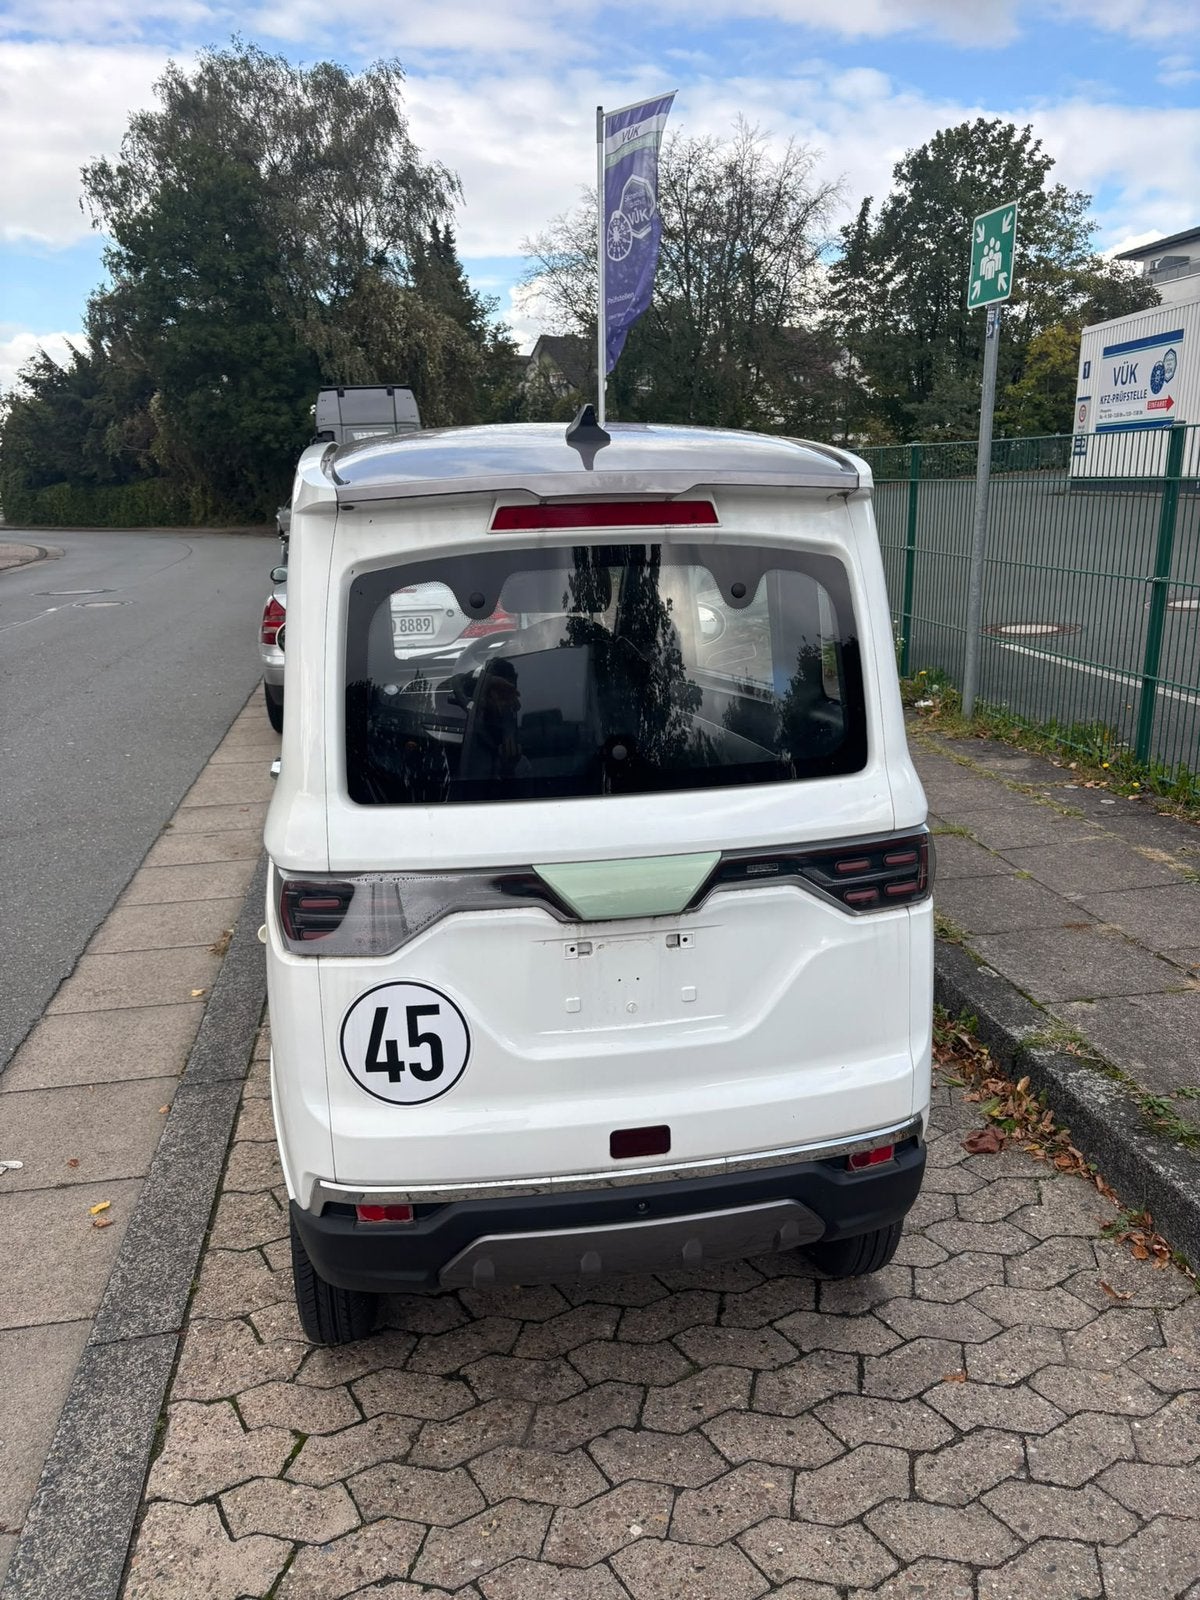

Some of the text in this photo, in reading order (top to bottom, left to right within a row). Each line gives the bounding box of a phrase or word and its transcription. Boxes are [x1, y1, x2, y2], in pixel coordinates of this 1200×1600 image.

[622, 125, 641, 143] VÜK
[1113, 360, 1139, 387] VÜK
[1101, 389, 1148, 404] KFZ-PRÜFSTELLE
[400, 617, 431, 633] 8889
[364, 1003, 444, 1083] 45
